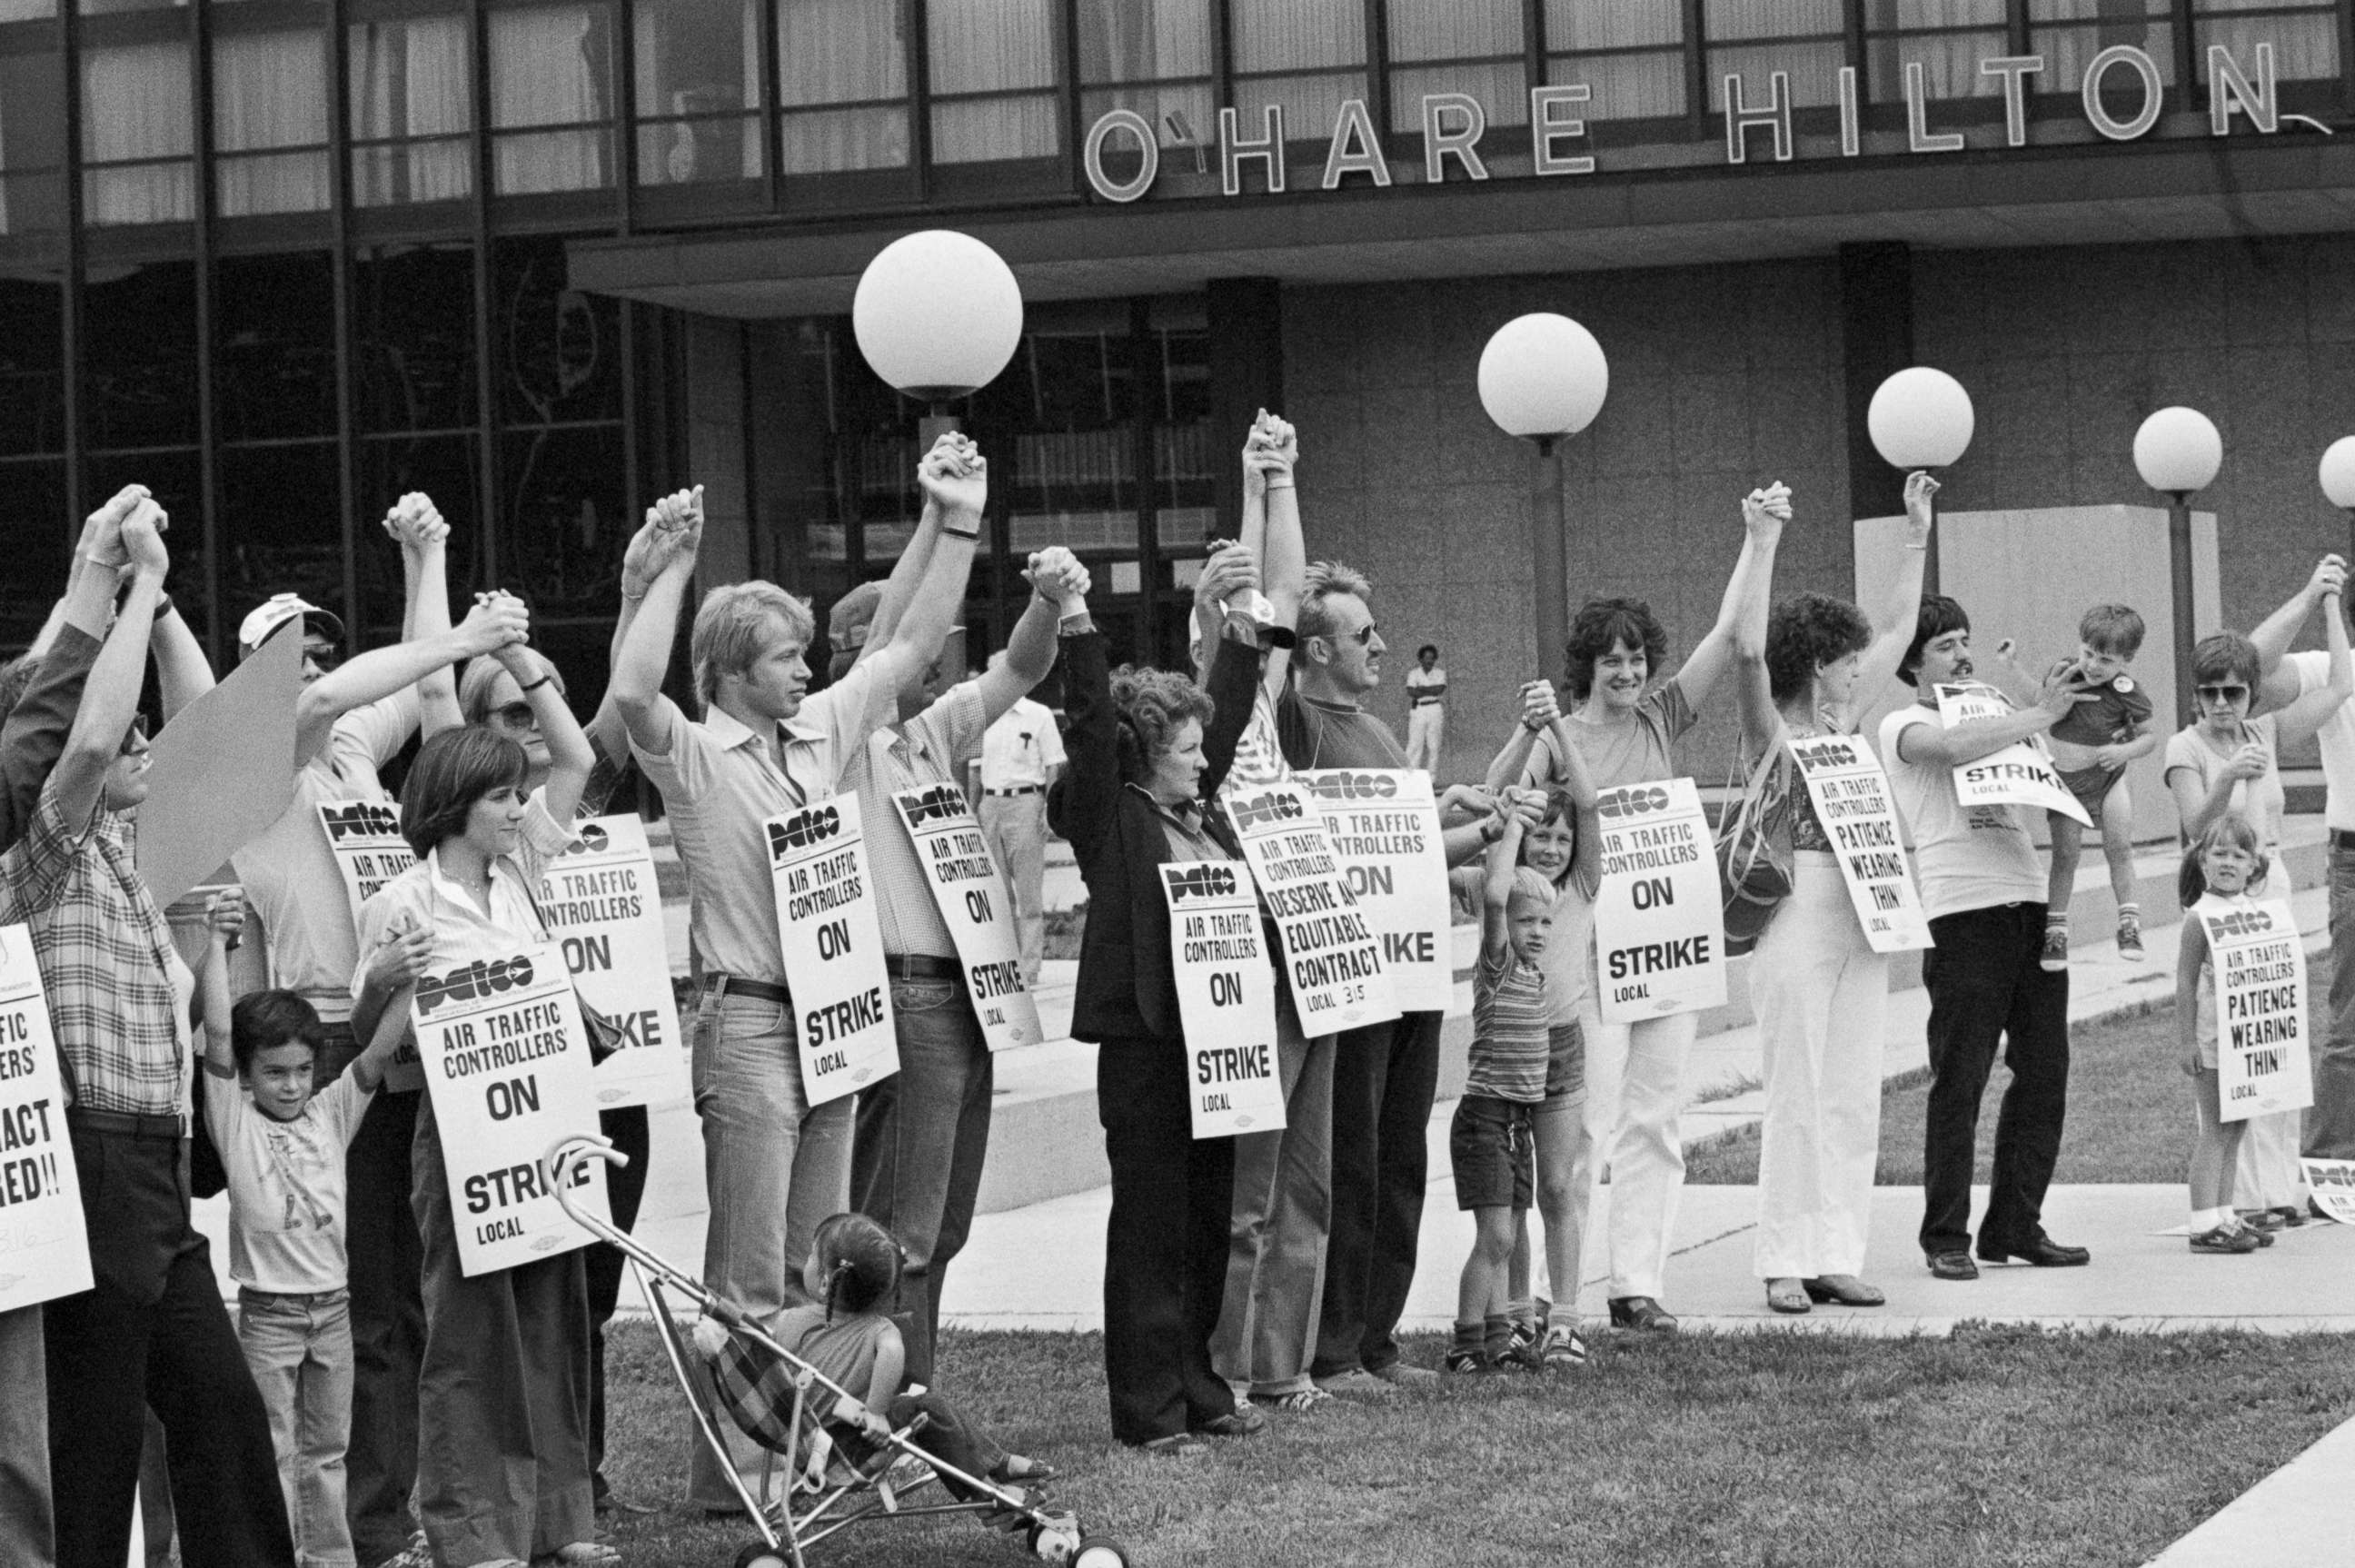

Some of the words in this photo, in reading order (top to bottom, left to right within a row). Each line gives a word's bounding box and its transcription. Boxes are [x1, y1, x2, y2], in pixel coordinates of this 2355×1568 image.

[1725, 43, 2278, 163] HILTON
[1597, 787, 1669, 818] atco
[1821, 781, 1839, 799] AIR
[1841, 778, 1881, 796] TRAFFIC
[1972, 784, 2011, 795] LOCAL
[1348, 814, 1420, 834] TRAFFIC
[1630, 823, 1694, 849] TRAFFIC
[1835, 820, 1895, 849] PATIENCE
[930, 838, 951, 859] AIR
[953, 833, 985, 855] TRAFFIC
[1259, 840, 1282, 860] AIR
[1285, 833, 1327, 855] TRAFFIC
[1331, 835, 1426, 856] NTROLLERS'
[353, 855, 376, 877] AIR
[788, 868, 810, 895] AIR
[813, 850, 857, 886] TRAFFIC
[1346, 866, 1394, 896] ON
[1849, 852, 1903, 880] WEARING
[561, 869, 637, 898] TRAFFIC
[1267, 881, 1338, 918] DESERVE
[1336, 879, 1358, 908] AN
[1632, 877, 1674, 910] ON
[537, 895, 642, 928] ONTROLLERS'
[966, 889, 993, 924] ON
[817, 918, 851, 961] ON
[1186, 917, 1205, 938] AIR
[1210, 913, 1252, 936] TRAFFIC
[1287, 913, 1372, 954] EQUITABLE
[1868, 918, 1892, 932] LOCAL
[561, 935, 611, 974] ON
[1382, 932, 1435, 963] IKE
[1609, 935, 1710, 979] STRIKE
[2227, 950, 2243, 968] AIR
[2249, 943, 2291, 964] TRAFFIC
[971, 960, 1025, 1000] STRIKE
[1295, 946, 1381, 989] CONTRACT
[1210, 972, 1242, 1007] ON
[1306, 992, 1336, 1012] LOCAL
[1343, 985, 1366, 1004] 315
[1615, 983, 1650, 1003] LOCAL
[2229, 985, 2297, 1019] PATIENCE
[443, 1023, 475, 1052] AIR
[485, 1002, 561, 1040] TRAFFIC
[806, 987, 884, 1047] STRIKE
[983, 1007, 1006, 1027] LOCAL
[2231, 1016, 2298, 1049] WEARING
[814, 1050, 848, 1077] LOCAL
[1197, 1045, 1270, 1085] STRIKE
[2244, 1047, 2288, 1077] THIN!!
[486, 1075, 540, 1121] ON
[1203, 1093, 1232, 1113] LOCAL
[2231, 1083, 2258, 1100] LOCAL
[476, 1216, 524, 1245] LOCAL
